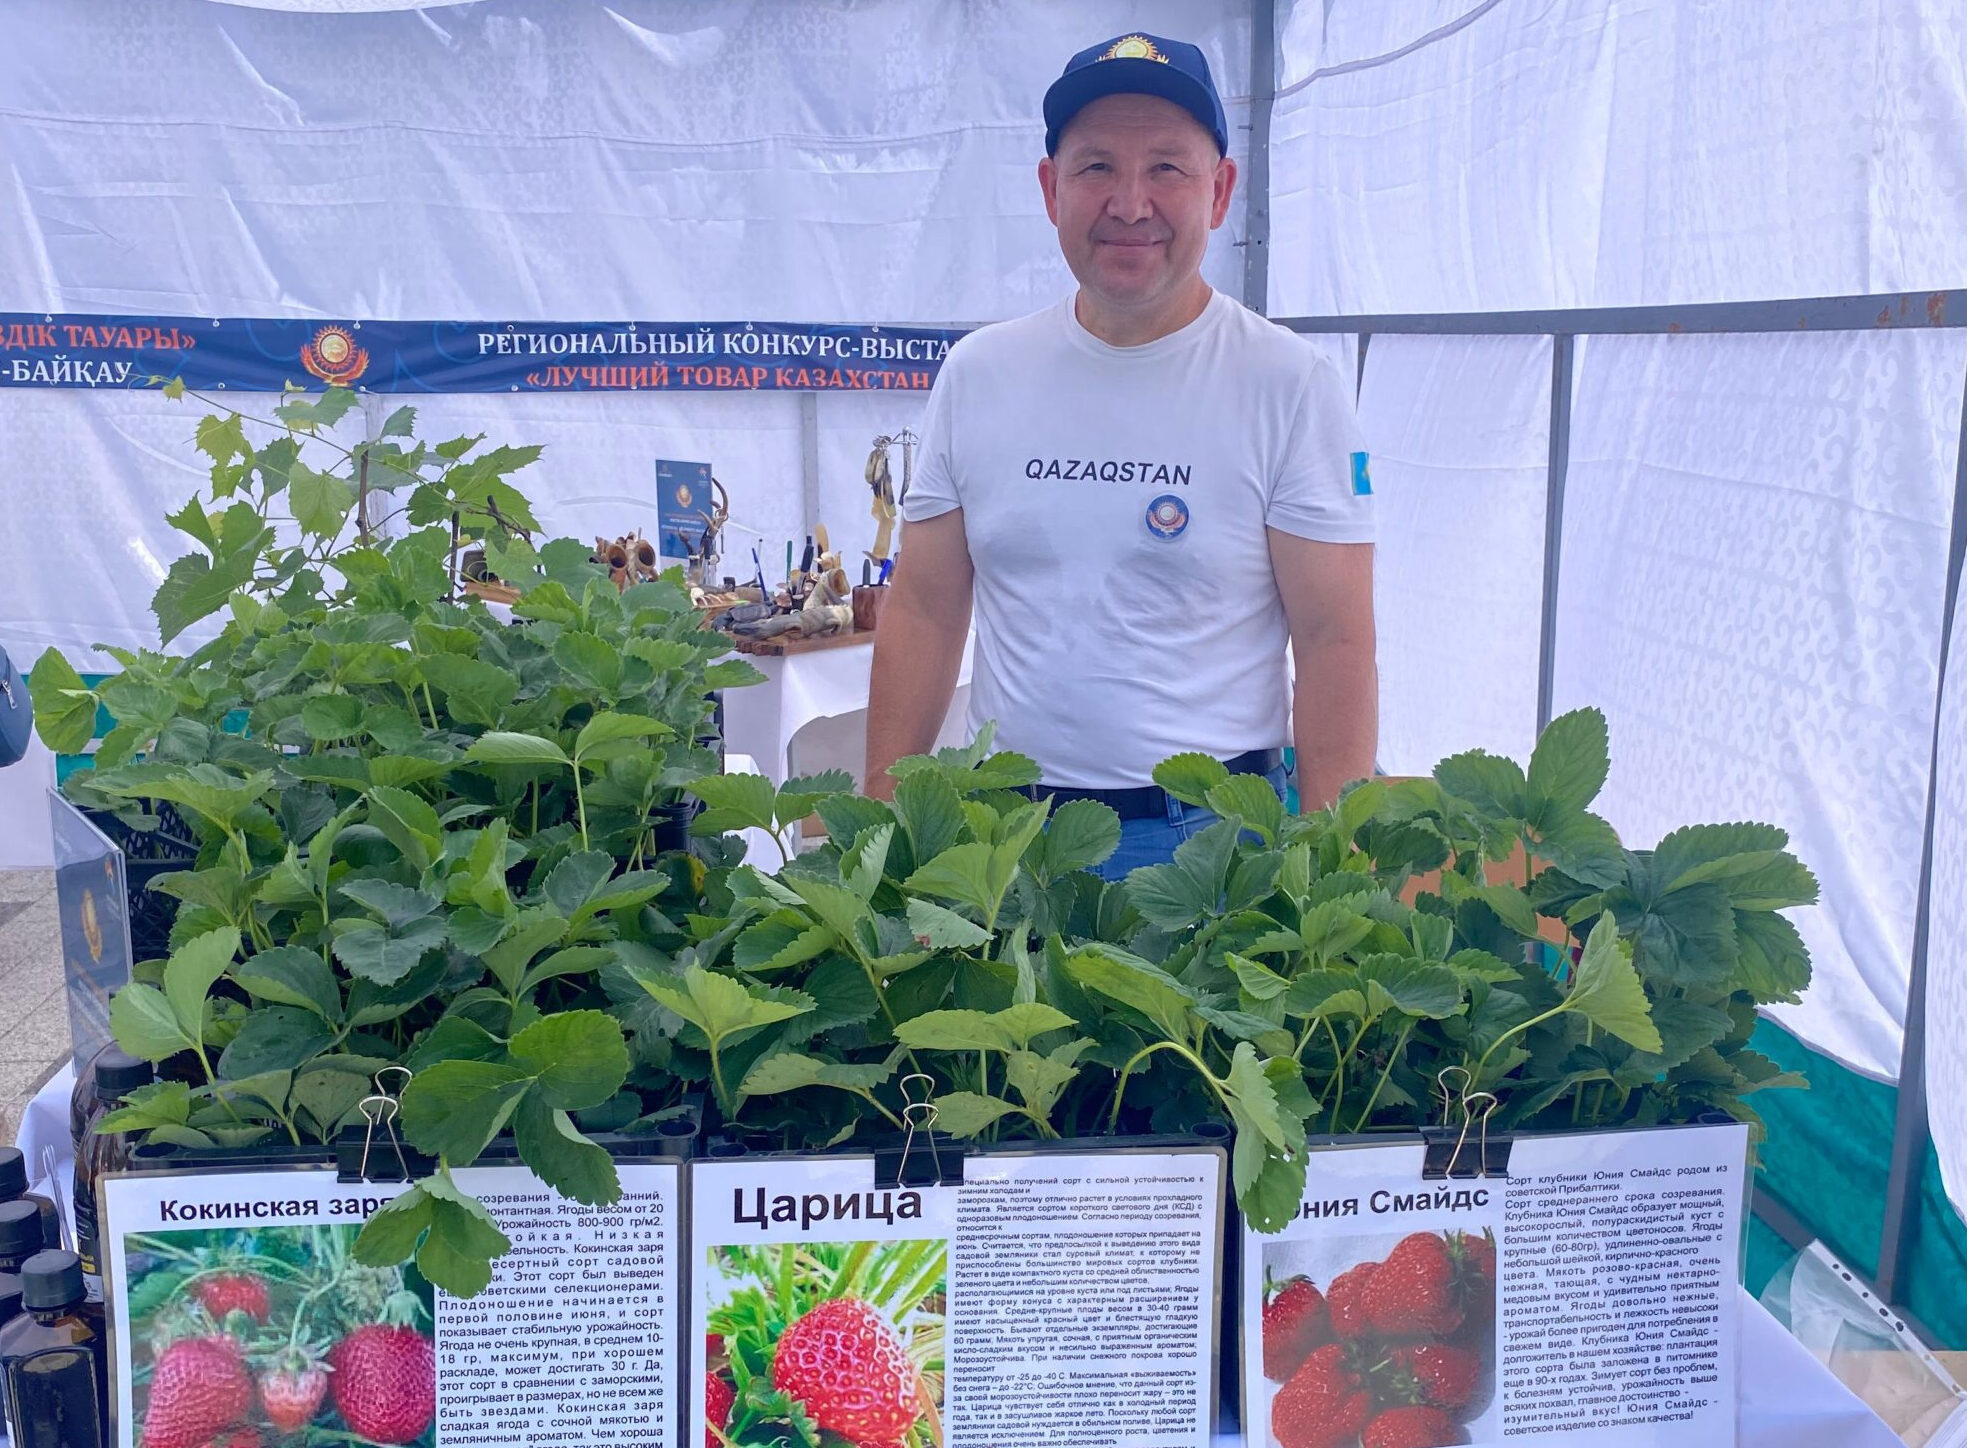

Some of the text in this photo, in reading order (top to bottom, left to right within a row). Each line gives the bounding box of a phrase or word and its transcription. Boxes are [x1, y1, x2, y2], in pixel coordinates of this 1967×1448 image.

[63, 325, 196, 350] ТАУАРЫ»
[478, 328, 716, 355] РЕГИОНАЛЬНЫЙ
[526, 361, 929, 390] «ЛУЧШИЙ ТОВАР КАЗАХСТАН
[1025, 459, 1191, 485] QAZAQSTAN
[1506, 1176, 1532, 1186] Сорт
[1538, 1173, 1586, 1184] клубники
[1593, 1171, 1623, 1180] Юния
[1630, 1168, 1671, 1177] Смайдс
[1677, 1166, 1710, 1177] родом
[476, 1194, 550, 1205] созревания
[1505, 1185, 1556, 1197] советской
[557, 1203, 663, 1215] Ягоды весом от 20
[734, 1187, 922, 1230] Царица
[1293, 1185, 1489, 1220] ния Смайдс
[1505, 1200, 1531, 1210] Сорт
[1537, 1195, 1618, 1208] среднераннего
[1624, 1192, 1655, 1203] срока
[160, 1199, 319, 1221] Кокинская
[1505, 1210, 1552, 1222] Клубника
[1556, 1208, 1585, 1217] Юния
[1588, 1205, 1628, 1215] Смайдс
[1631, 1202, 1677, 1213] образует
[578, 1216, 623, 1227] 800-900
[594, 1230, 663, 1239] Низкая
[1504, 1235, 1551, 1244] большим
[1556, 1229, 1620, 1240] количеством
[1691, 1222, 1722, 1231] Ягоды
[574, 1243, 663, 1254] Кокинская заря
[567, 1255, 663, 1268] сорт садовой
[1546, 1268, 1585, 1276] Мякоть
[1689, 1257, 1720, 1266] очень
[513, 1269, 663, 1282] Этот сорт был выведен
[439, 1295, 663, 1311] Плодоношение начинается в
[1570, 1301, 1605, 1310] Ягоды
[1612, 1296, 1666, 1309] довольно
[439, 1313, 487, 1325] первой
[497, 1312, 562, 1322] половине
[634, 1308, 664, 1318] сорт
[439, 1327, 507, 1337] показывает
[512, 1324, 581, 1335] стабильную
[439, 1340, 474, 1351] Ягода
[477, 1341, 491, 1349] не
[494, 1340, 528, 1348] очень
[584, 1337, 590, 1345] в
[594, 1335, 642, 1346] среднем
[647, 1332, 663, 1342] 10-
[440, 1354, 455, 1364] 18
[572, 1351, 595, 1361] при
[604, 1348, 663, 1359] хорошем
[1503, 1367, 1529, 1376] этого
[1535, 1364, 1563, 1374] сорта
[1569, 1361, 1595, 1370] была
[1601, 1356, 1649, 1367] заложена
[1666, 1350, 1718, 1362] питомнике
[505, 1366, 541, 1375] может
[547, 1364, 604, 1375] достигать
[611, 1360, 625, 1370] 30
[1535, 1375, 1556, 1385] 90-х
[1591, 1370, 1627, 1380] Зимует
[1629, 1368, 1651, 1377] сорт
[1653, 1365, 1670, 1375] без
[440, 1382, 464, 1391] этот
[470, 1381, 496, 1391] сорт
[513, 1378, 574, 1390] сравнении
[580, 1377, 586, 1385] с
[440, 1394, 514, 1406] проигрывает
[586, 1390, 600, 1398] но
[618, 1389, 646, 1397] всем
[648, 1388, 663, 1396] же
[440, 1407, 472, 1418] быть
[557, 1403, 625, 1413] Кокинская
[634, 1401, 663, 1412] заря
[440, 1422, 488, 1432] сладкая
[497, 1420, 529, 1430] ягода
[537, 1419, 543, 1427] с
[550, 1416, 591, 1427] сочной
[599, 1415, 649, 1424] мякотью
[1504, 1425, 1553, 1435] советское
[1555, 1421, 1596, 1431] изделие
[1610, 1416, 1645, 1426] знаком
[1647, 1410, 1693, 1422] качества!
[440, 1434, 520, 1445] земляничным
[591, 1428, 615, 1438] Чем
[620, 1428, 663, 1439] хороша
